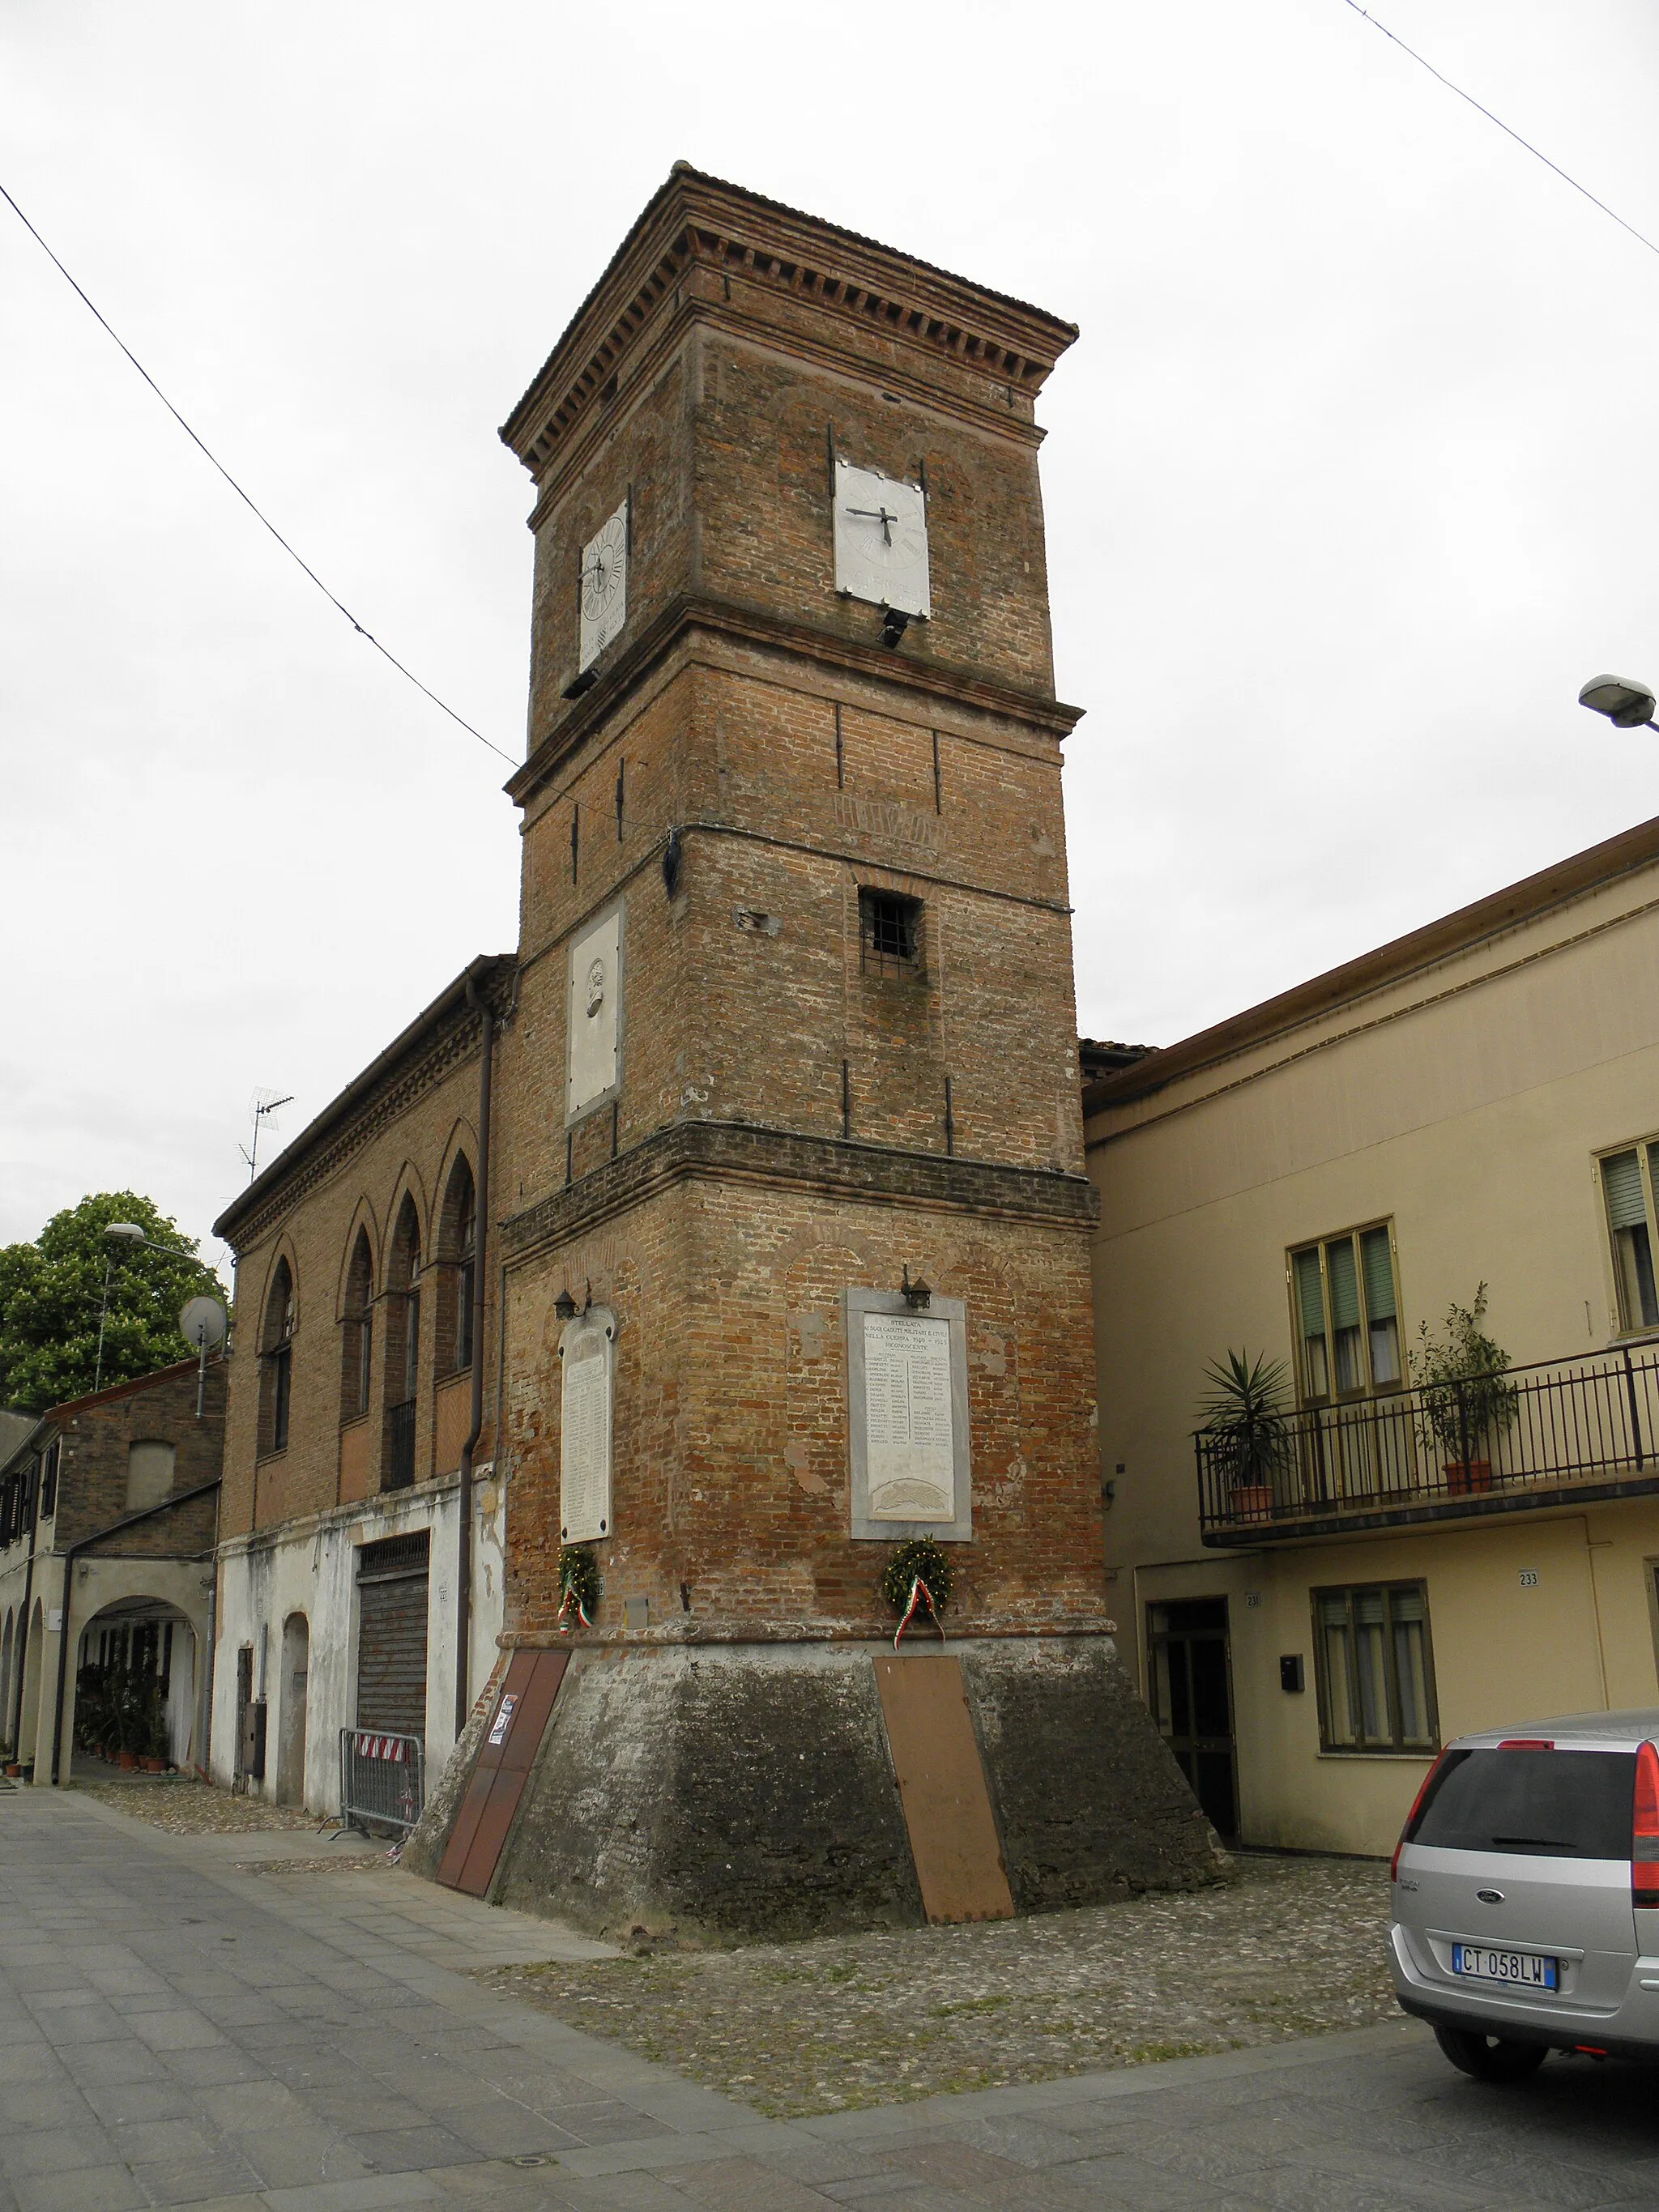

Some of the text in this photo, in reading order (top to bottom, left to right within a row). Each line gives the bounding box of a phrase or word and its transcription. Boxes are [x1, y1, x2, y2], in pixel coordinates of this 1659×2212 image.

[885, 1342, 928, 1350] RICONOSCENTE
[1520, 1573, 1537, 1585] 233
[1248, 1596, 1259, 1606] 231
[1464, 1948, 1482, 1972] CT
[1489, 1952, 1542, 1983] 058LW
